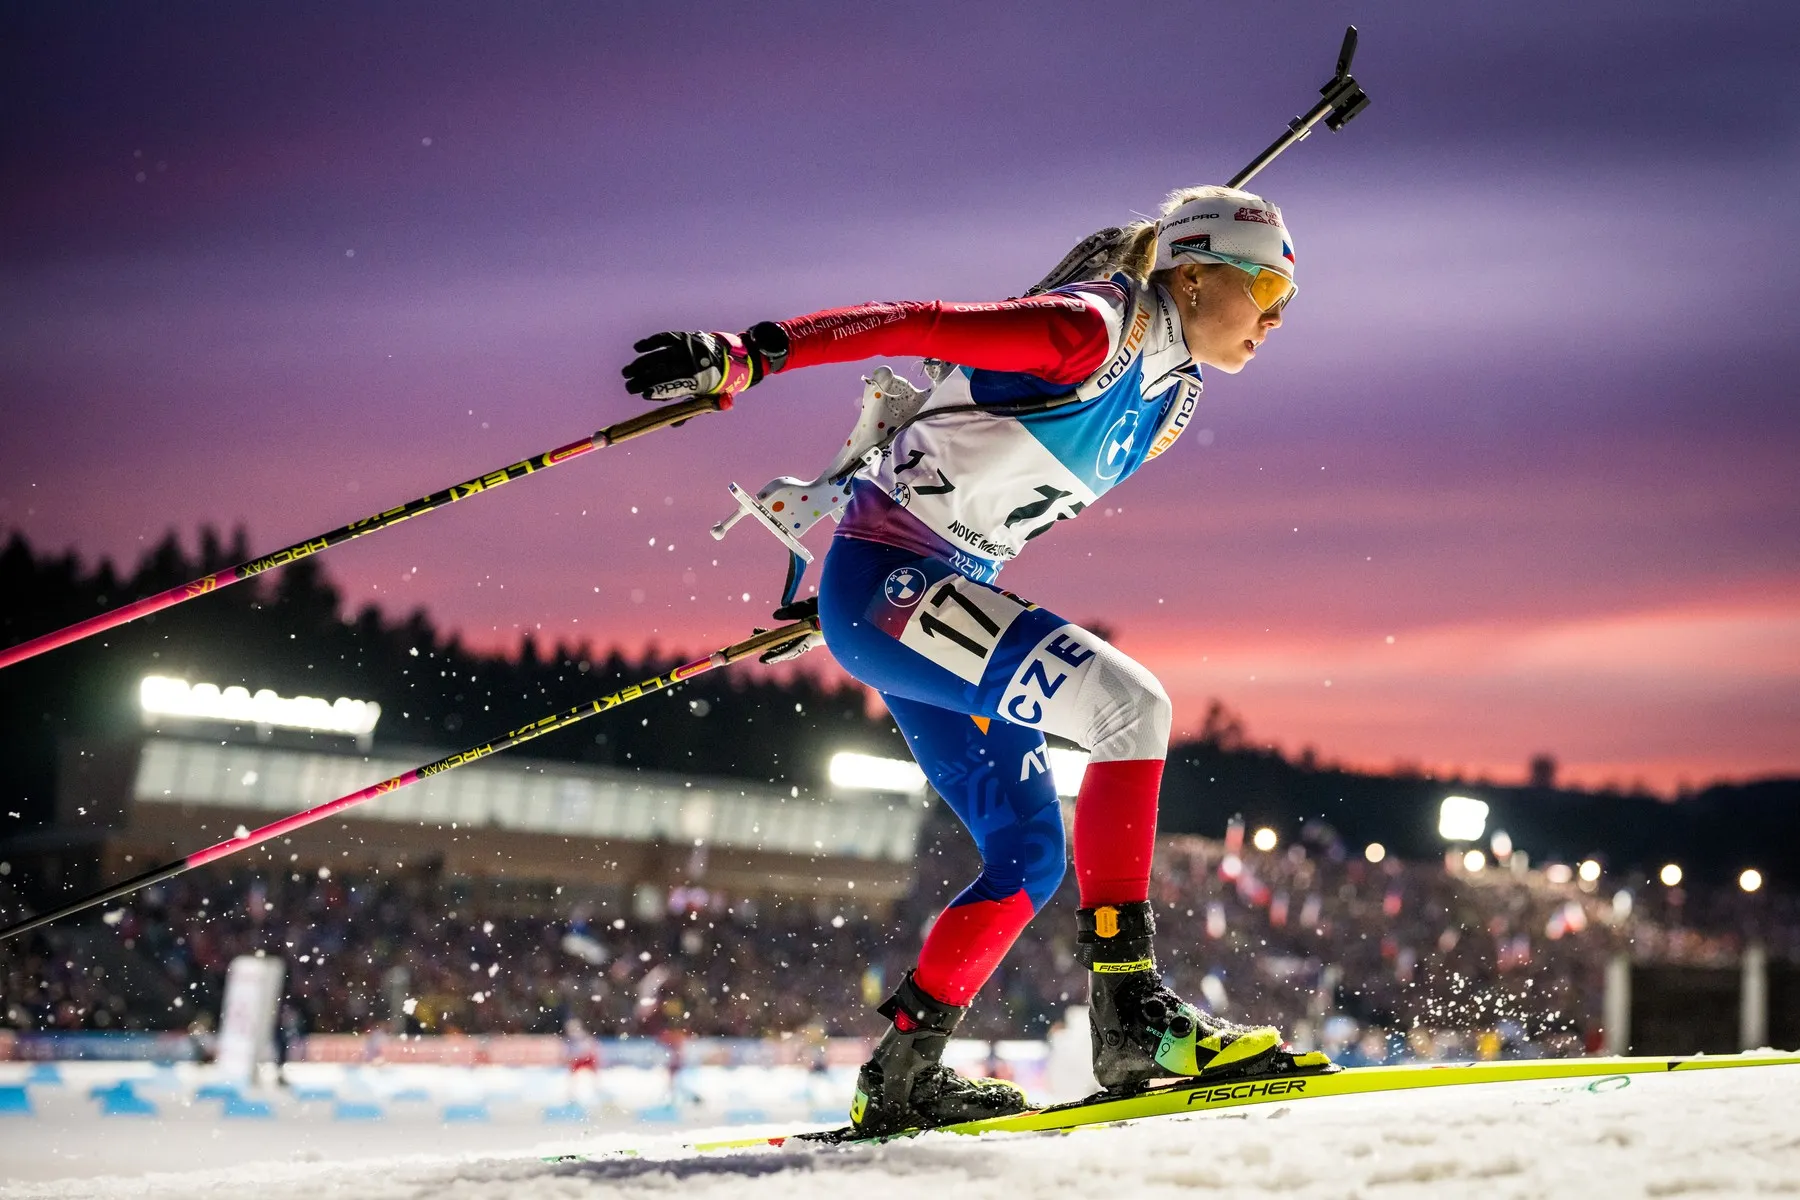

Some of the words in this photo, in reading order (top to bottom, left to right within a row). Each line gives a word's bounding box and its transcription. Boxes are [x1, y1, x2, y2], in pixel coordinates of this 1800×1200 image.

[1192, 213, 1219, 221] PRO
[954, 303, 998, 312] PRO
[833, 316, 881, 341] GENERALI
[1166, 318, 1174, 343] PRO
[1097, 306, 1151, 390] OCUTEIN
[725, 373, 745, 393] EKI
[449, 460, 535, 502] LEKI
[894, 449, 956, 495] 17
[947, 520, 983, 546] NOVÉ
[949, 550, 988, 579] NEW
[919, 582, 1001, 659] 17
[1007, 633, 1097, 725] CZE
[593, 677, 664, 713] LEKI
[1098, 963, 1150, 972] FISCHER
[1160, 1043, 1171, 1058] 9
[1187, 1079, 1306, 1105] FISCHER
